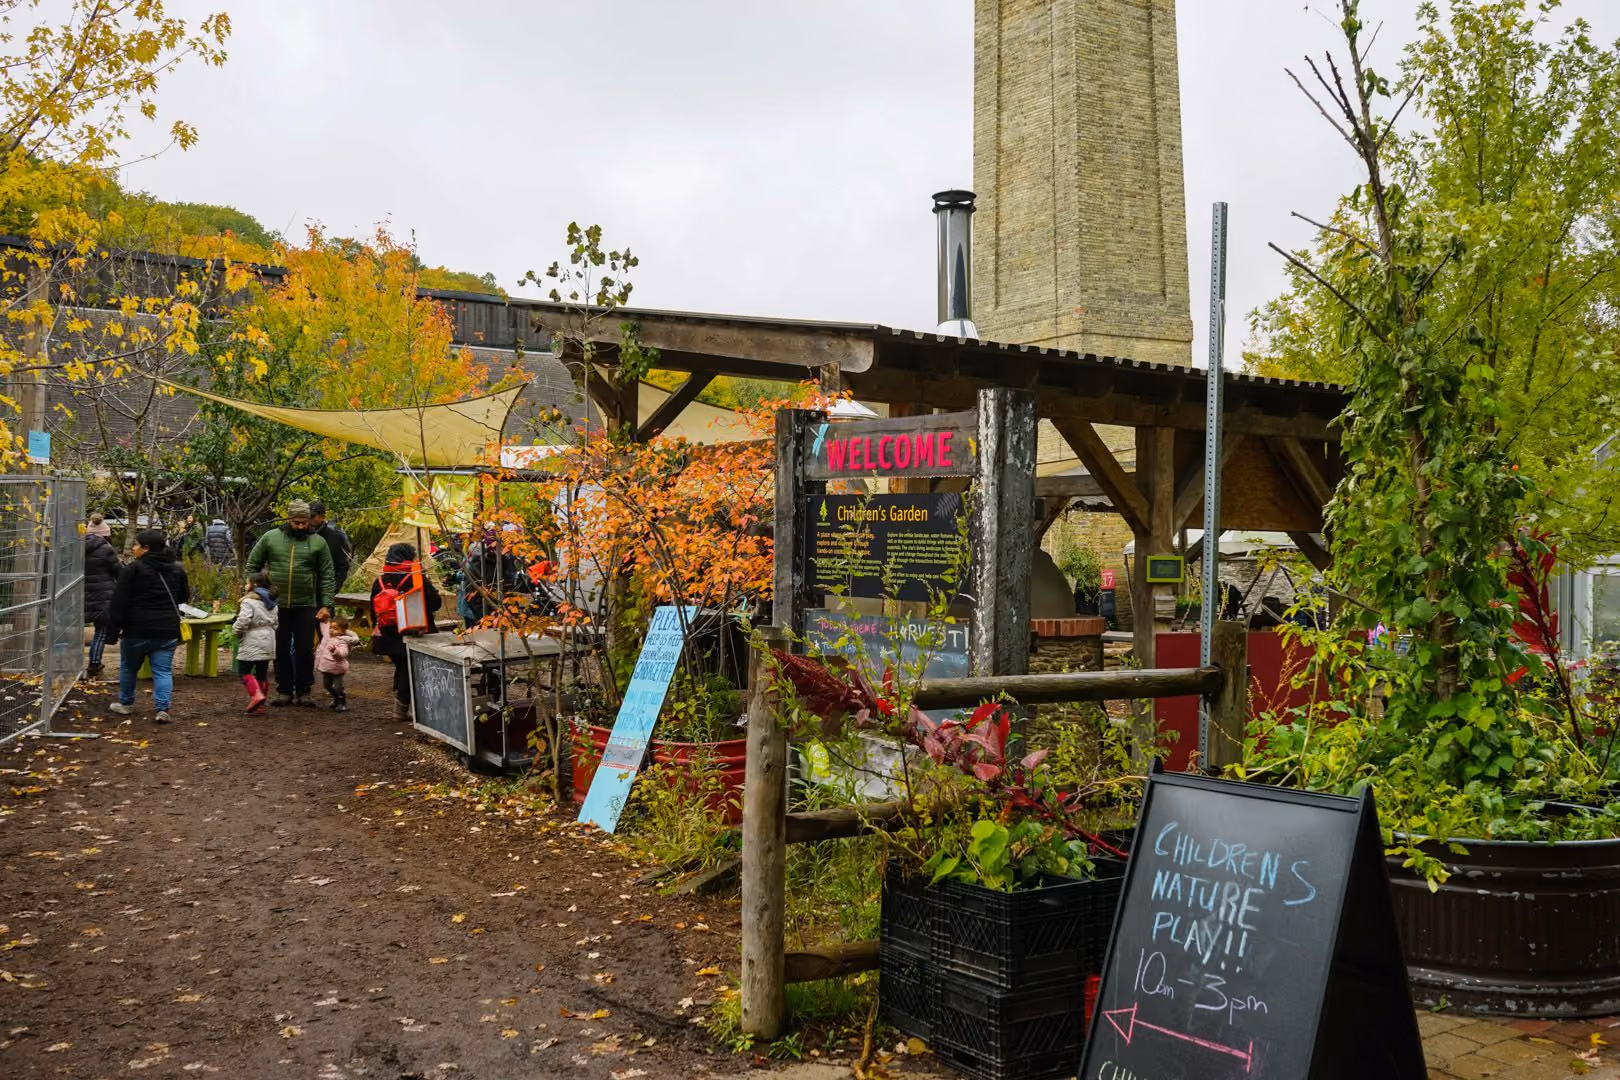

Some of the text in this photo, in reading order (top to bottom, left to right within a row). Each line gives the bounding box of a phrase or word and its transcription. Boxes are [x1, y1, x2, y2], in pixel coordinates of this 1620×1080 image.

[826, 431, 954, 472] WELCOME
[837, 504, 929, 522] Children's Garden
[1151, 869, 1266, 931] NATURE
[1152, 911, 1248, 973] PLAY!!
